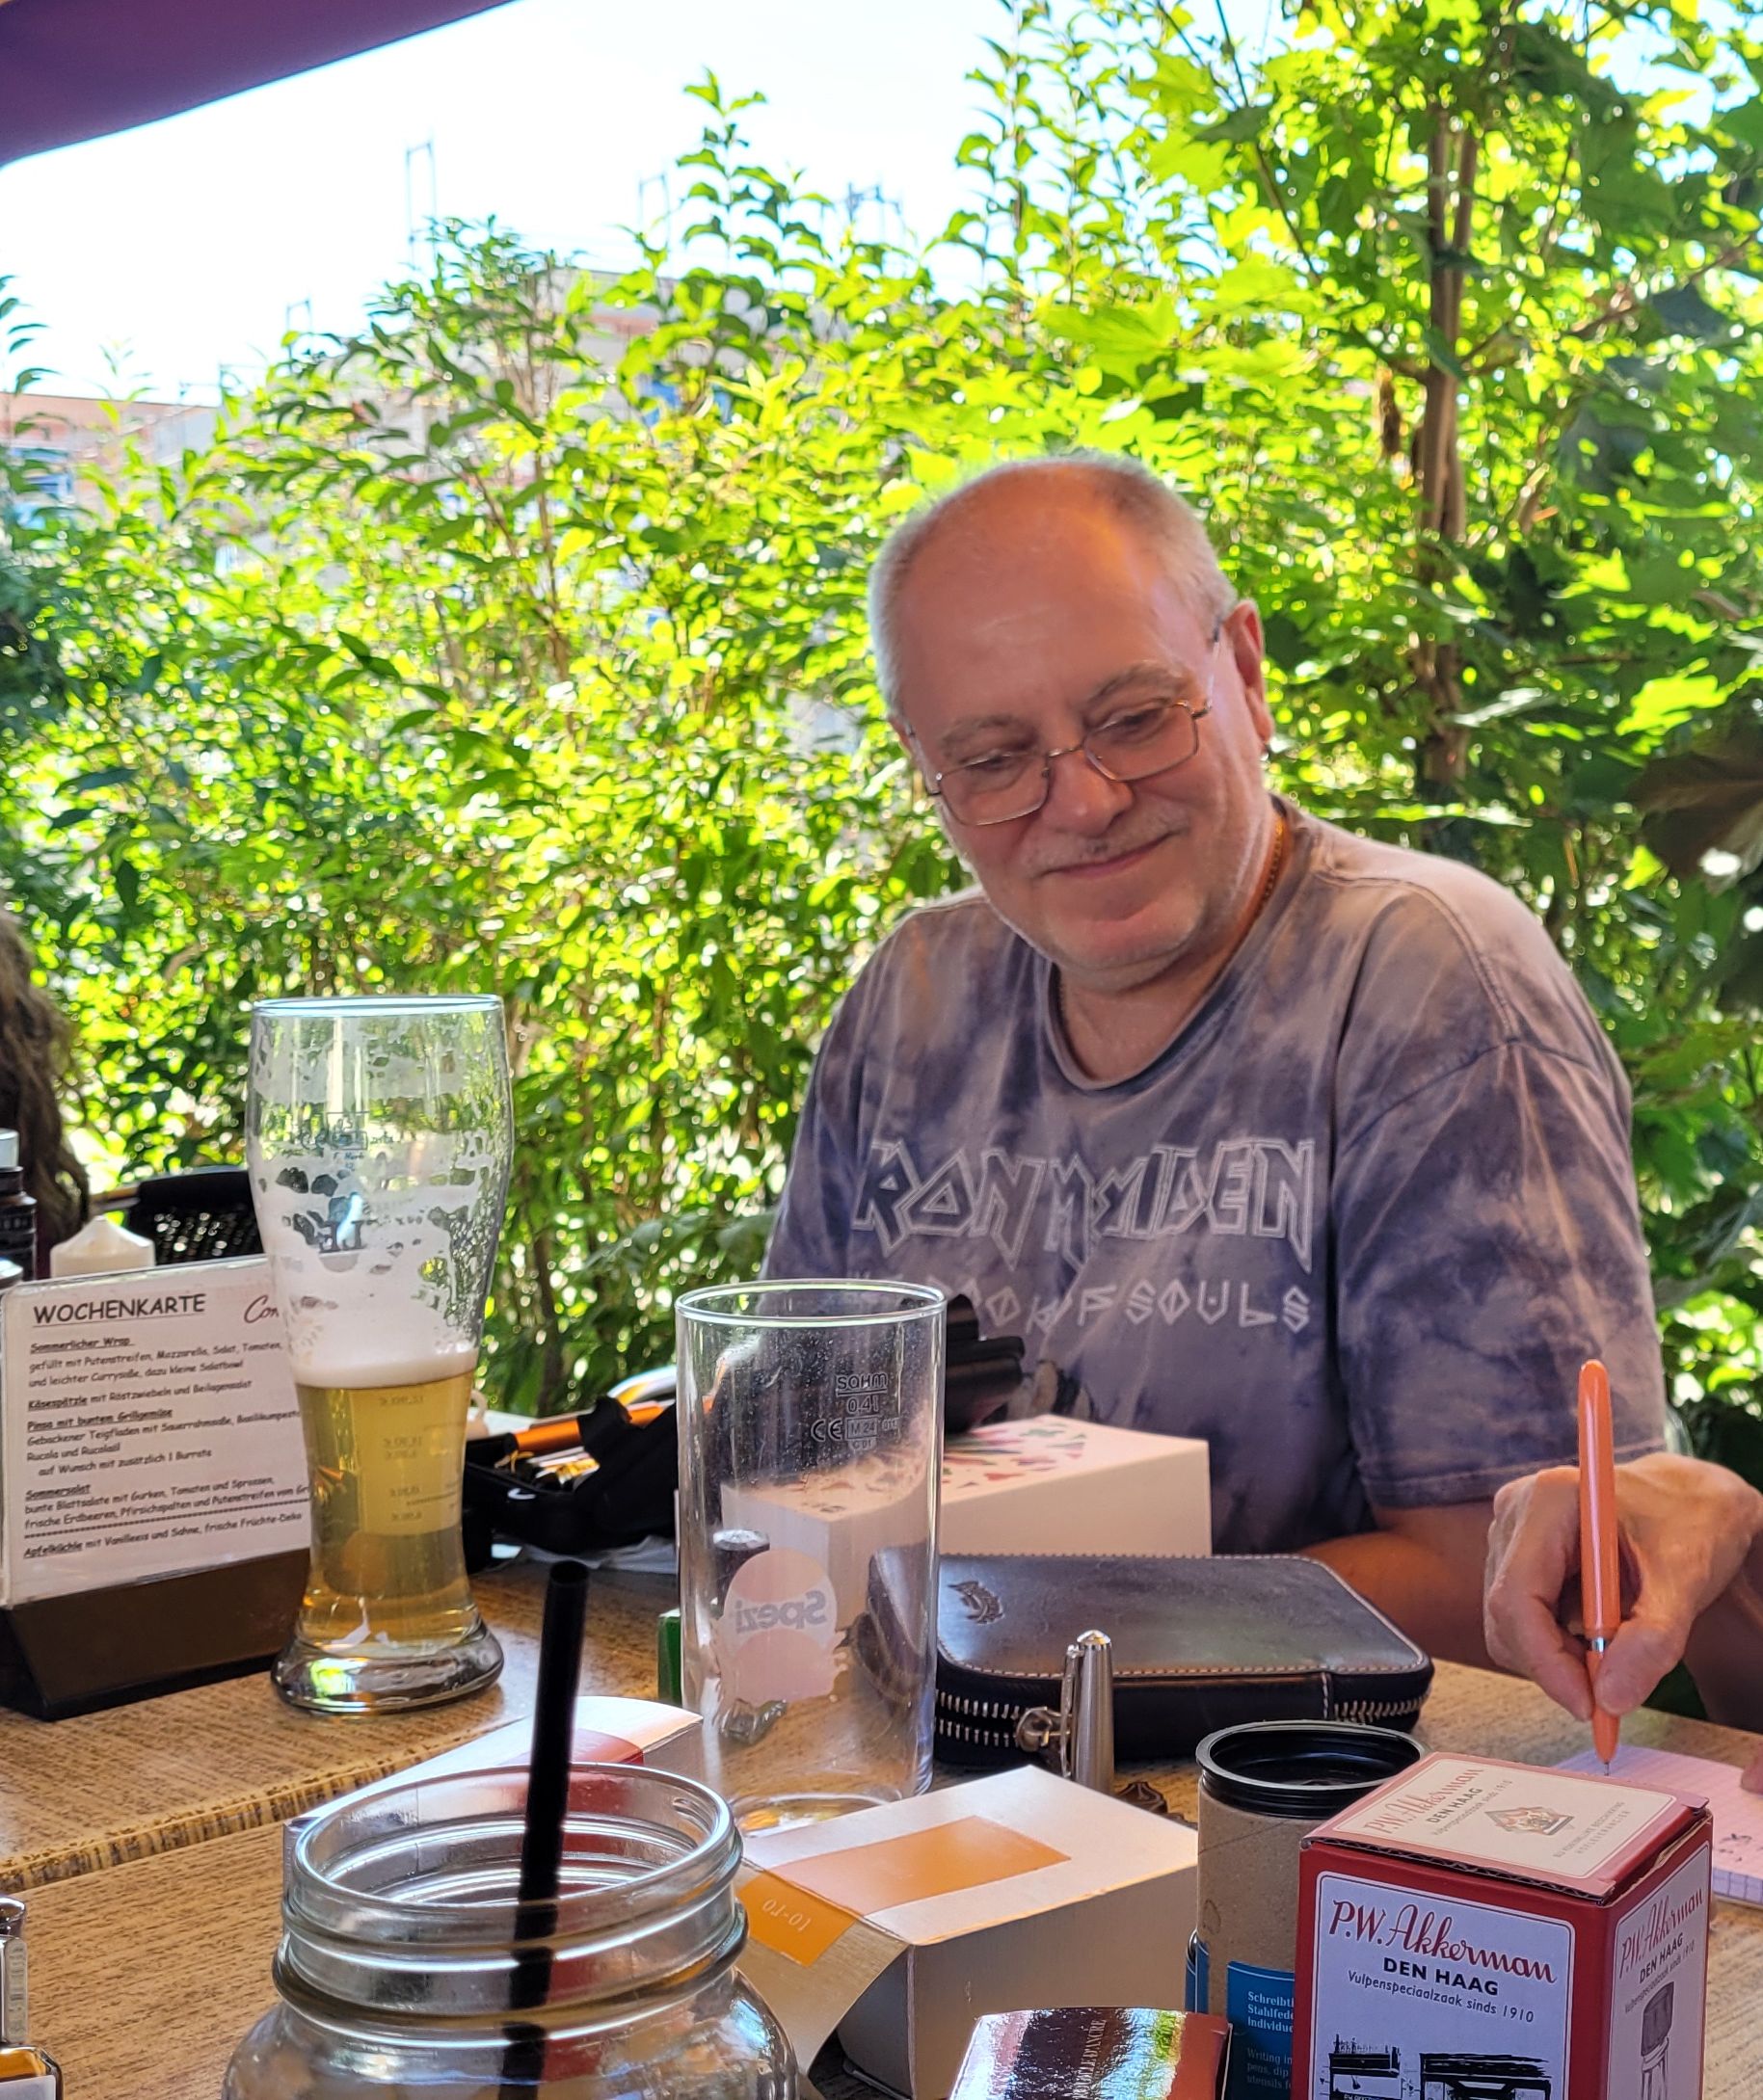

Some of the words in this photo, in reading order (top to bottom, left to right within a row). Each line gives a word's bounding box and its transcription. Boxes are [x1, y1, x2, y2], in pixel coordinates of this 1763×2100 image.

[852, 1137, 1047, 1272] RON
[33, 1293, 206, 1324] WOCHENKARTE
[244, 1294, 280, 1323] Con
[1125, 1278, 1311, 1334] SOULS
[66, 1359, 83, 1368] mit
[49, 1374, 89, 1386] leichter
[91, 1395, 106, 1403] mit
[174, 1385, 190, 1396] und
[57, 1419, 74, 1427] mit
[811, 1419, 842, 1442] CE
[61, 1448, 79, 1457] und
[112, 1494, 128, 1502] mit
[85, 1539, 102, 1548] mit
[1427, 1808, 1452, 1823] DEN
[1452, 1787, 1483, 1810] HAAG
[1385, 1903, 1557, 1983] Akkerman
[1640, 1955, 1657, 1983] DEN
[1659, 1932, 1684, 1966] HAAG
[1383, 1957, 1427, 1980] DEN
[1435, 1968, 1499, 1995] HAAG
[1349, 1970, 1463, 2007] Vulpenspeciaalzaak
[1466, 1998, 1497, 2014] sinds
[1502, 2005, 1535, 2023] 1910
[1246, 2047, 1281, 2064] Writing
[1284, 2053, 1293, 2064] in
[1272, 2064, 1289, 2078] dip
